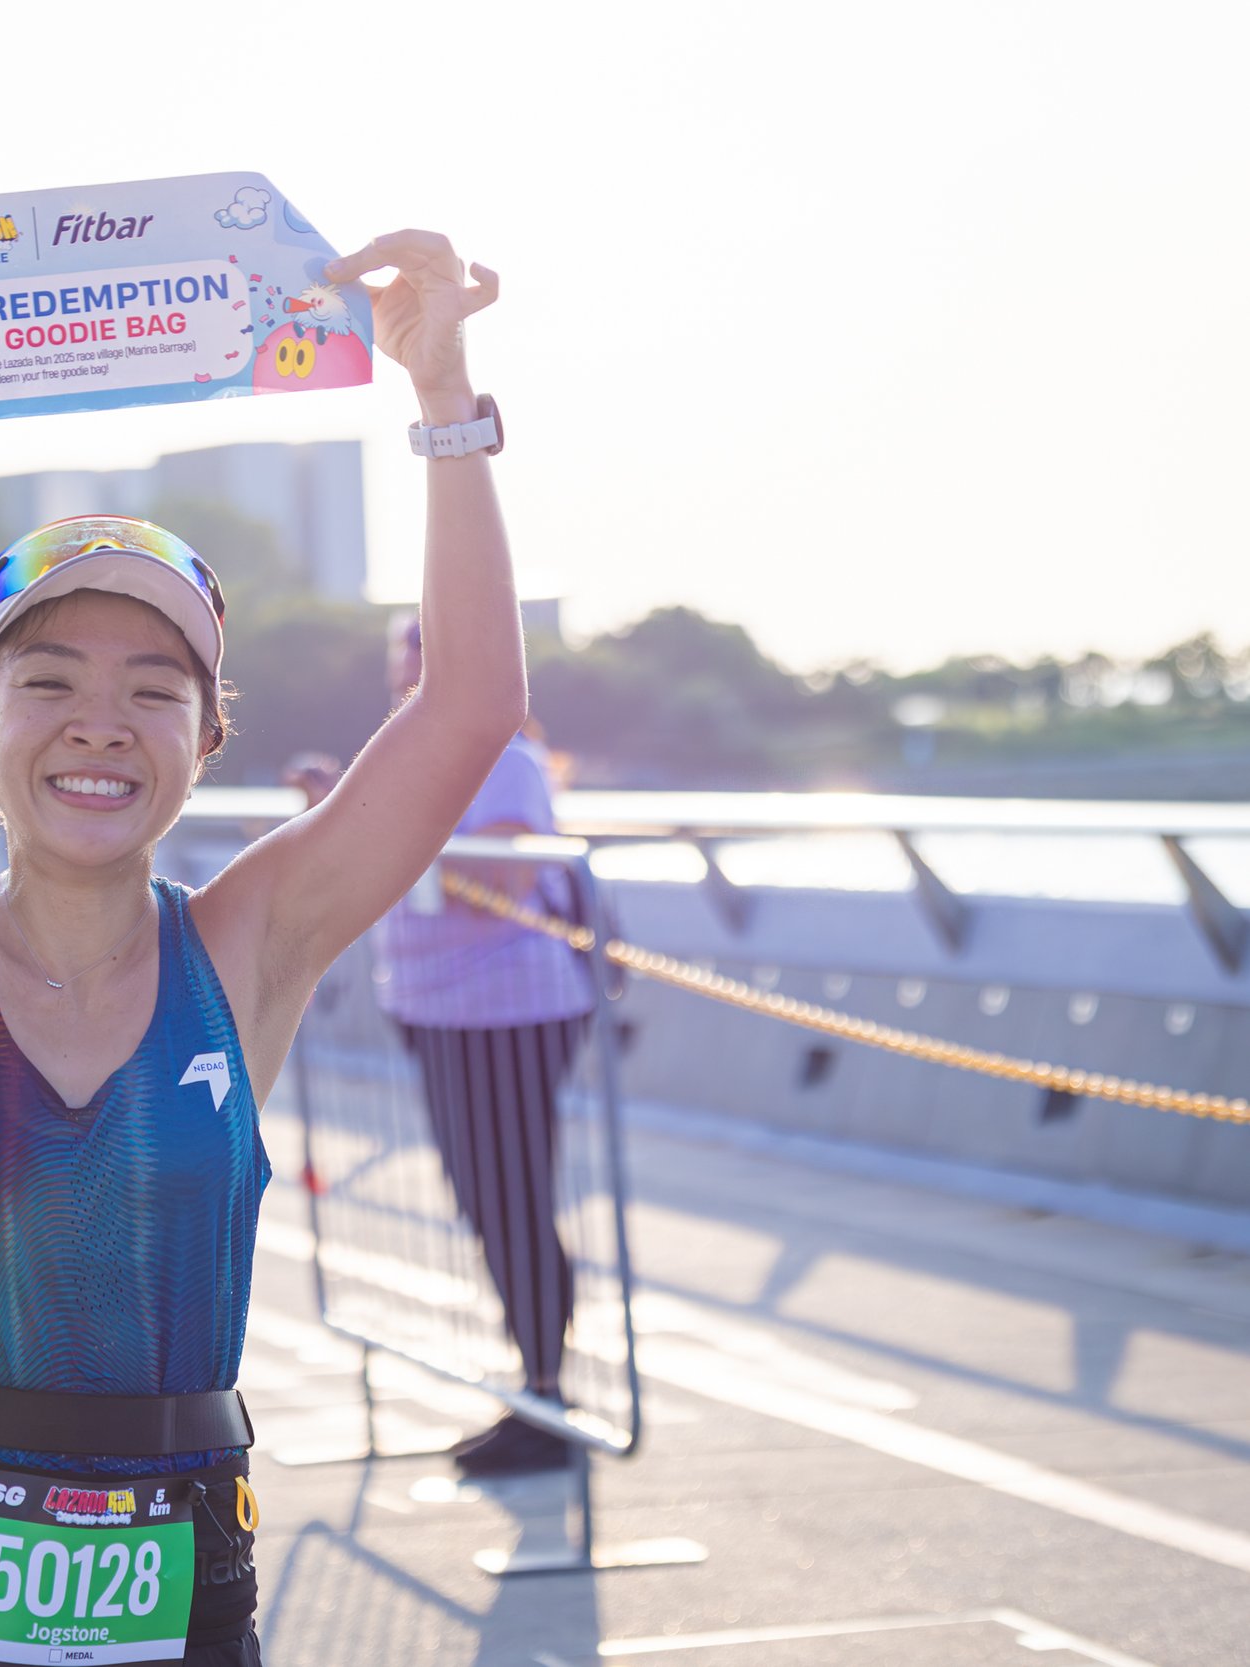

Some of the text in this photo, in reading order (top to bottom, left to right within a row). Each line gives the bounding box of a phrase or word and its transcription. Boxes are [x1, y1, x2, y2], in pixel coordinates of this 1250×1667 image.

[52, 211, 154, 246] Fitbar
[5, 319, 117, 350] GOODIE
[126, 312, 187, 338] BAG
[3, 356, 33, 368] Lazada
[35, 354, 52, 366] Run
[53, 352, 75, 364] 2025
[76, 351, 95, 362] race
[97, 346, 124, 361] village
[21, 371, 40, 383] your
[42, 368, 59, 379] free
[61, 366, 89, 380] goodie
[90, 363, 109, 376] bag!
[193, 1062, 224, 1072] NEDAO
[46, 1486, 108, 1513] LAZADA
[155, 1488, 165, 1503] 5
[149, 1502, 171, 1517] km
[26, 1622, 117, 1646] Jogstone_
[65, 1651, 94, 1661] MEDAL
